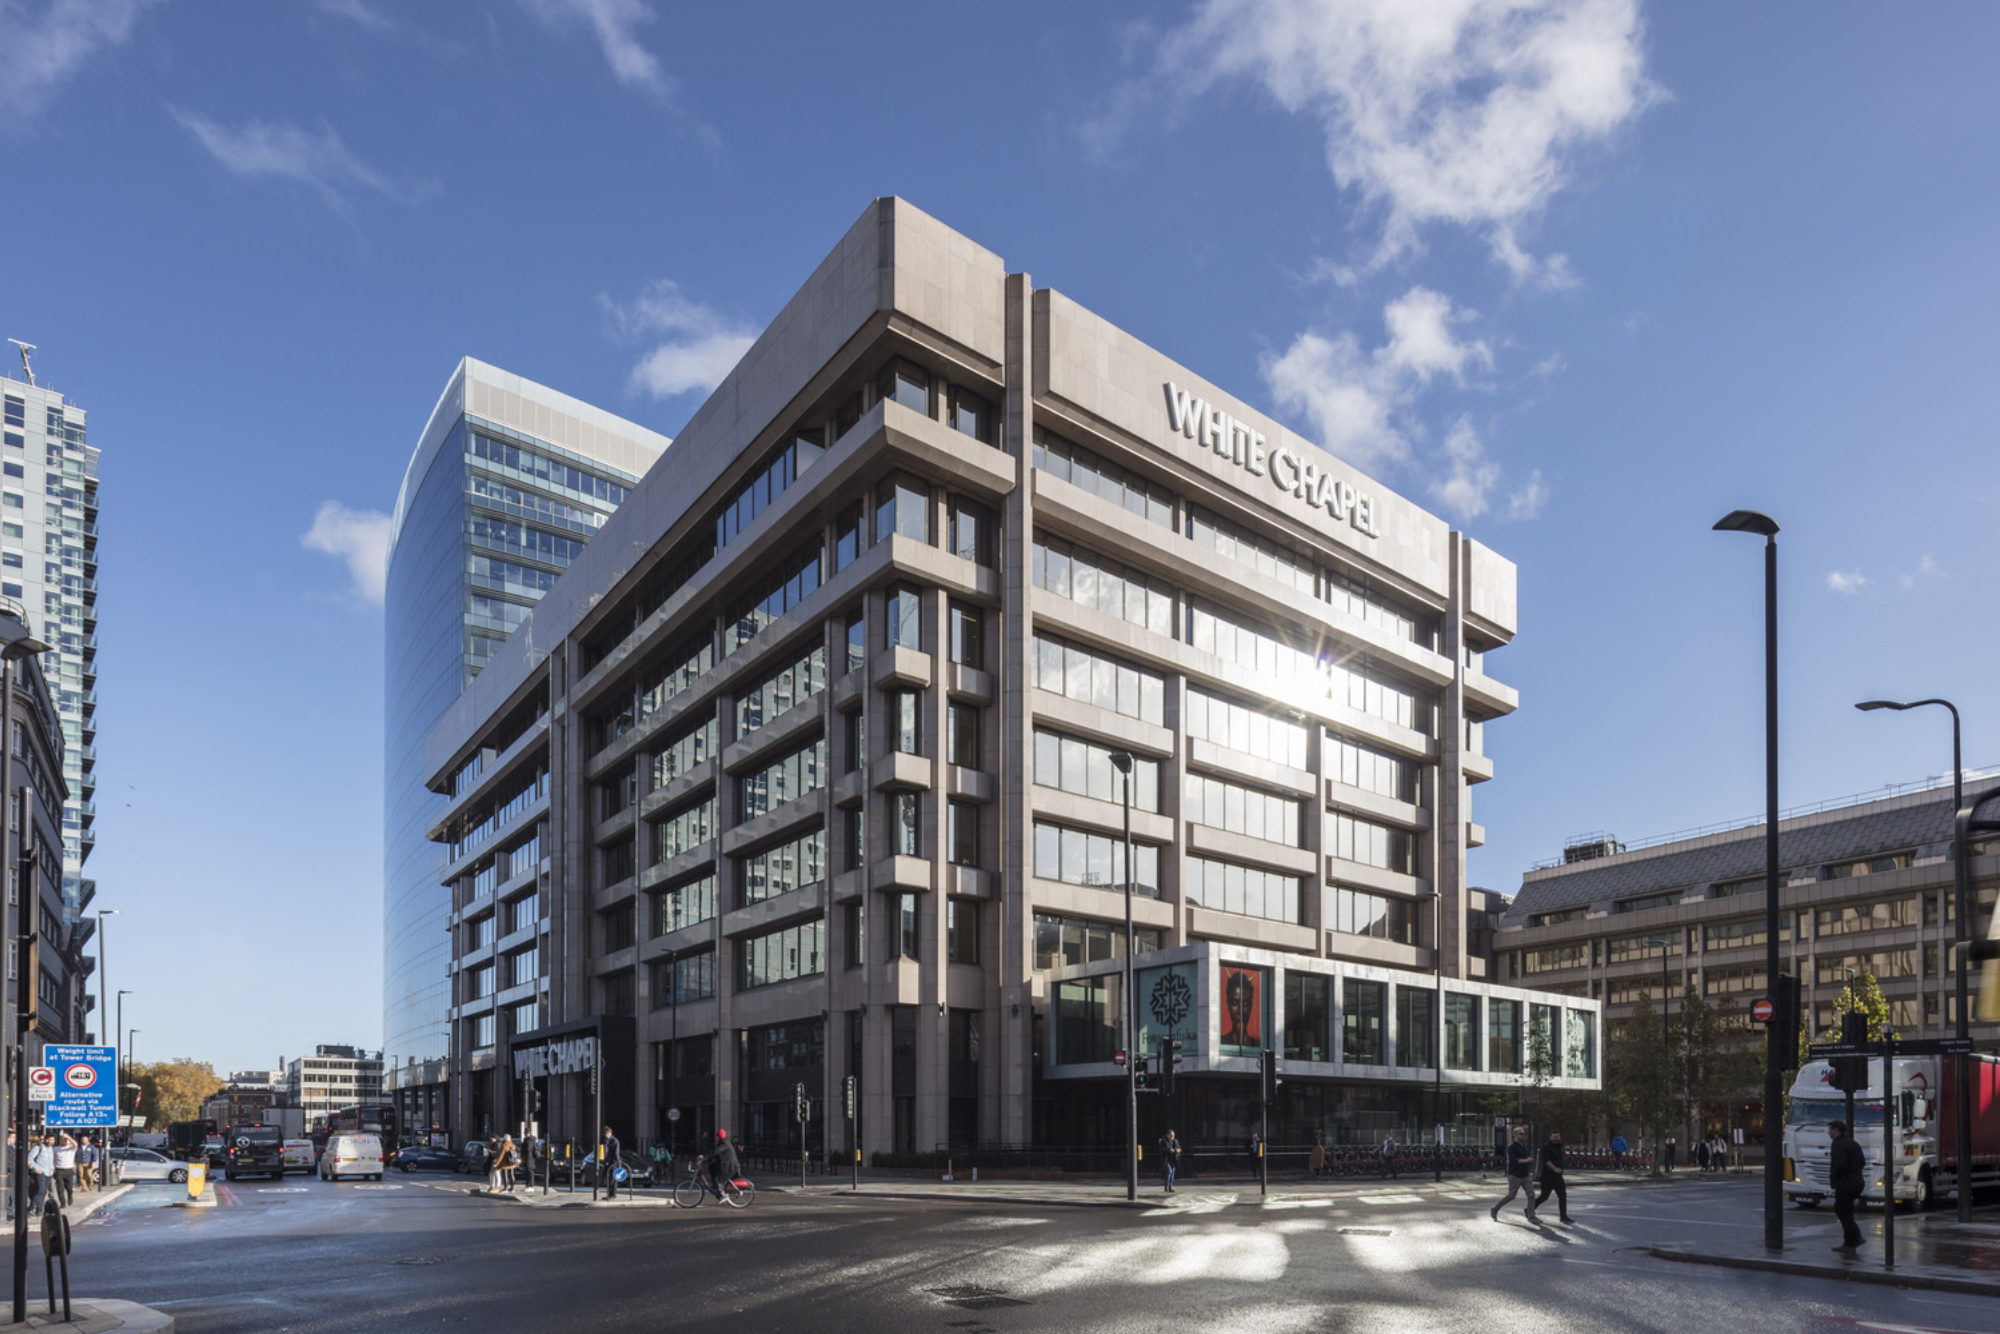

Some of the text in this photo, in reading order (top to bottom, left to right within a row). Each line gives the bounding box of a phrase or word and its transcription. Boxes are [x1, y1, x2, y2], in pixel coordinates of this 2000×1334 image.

[1162, 381, 1380, 539] WHITE CHAPEL
[57, 1047, 85, 1055] Weight
[514, 1036, 596, 1080] WHITE CHAPEL
[59, 1110, 86, 1118] Follow
